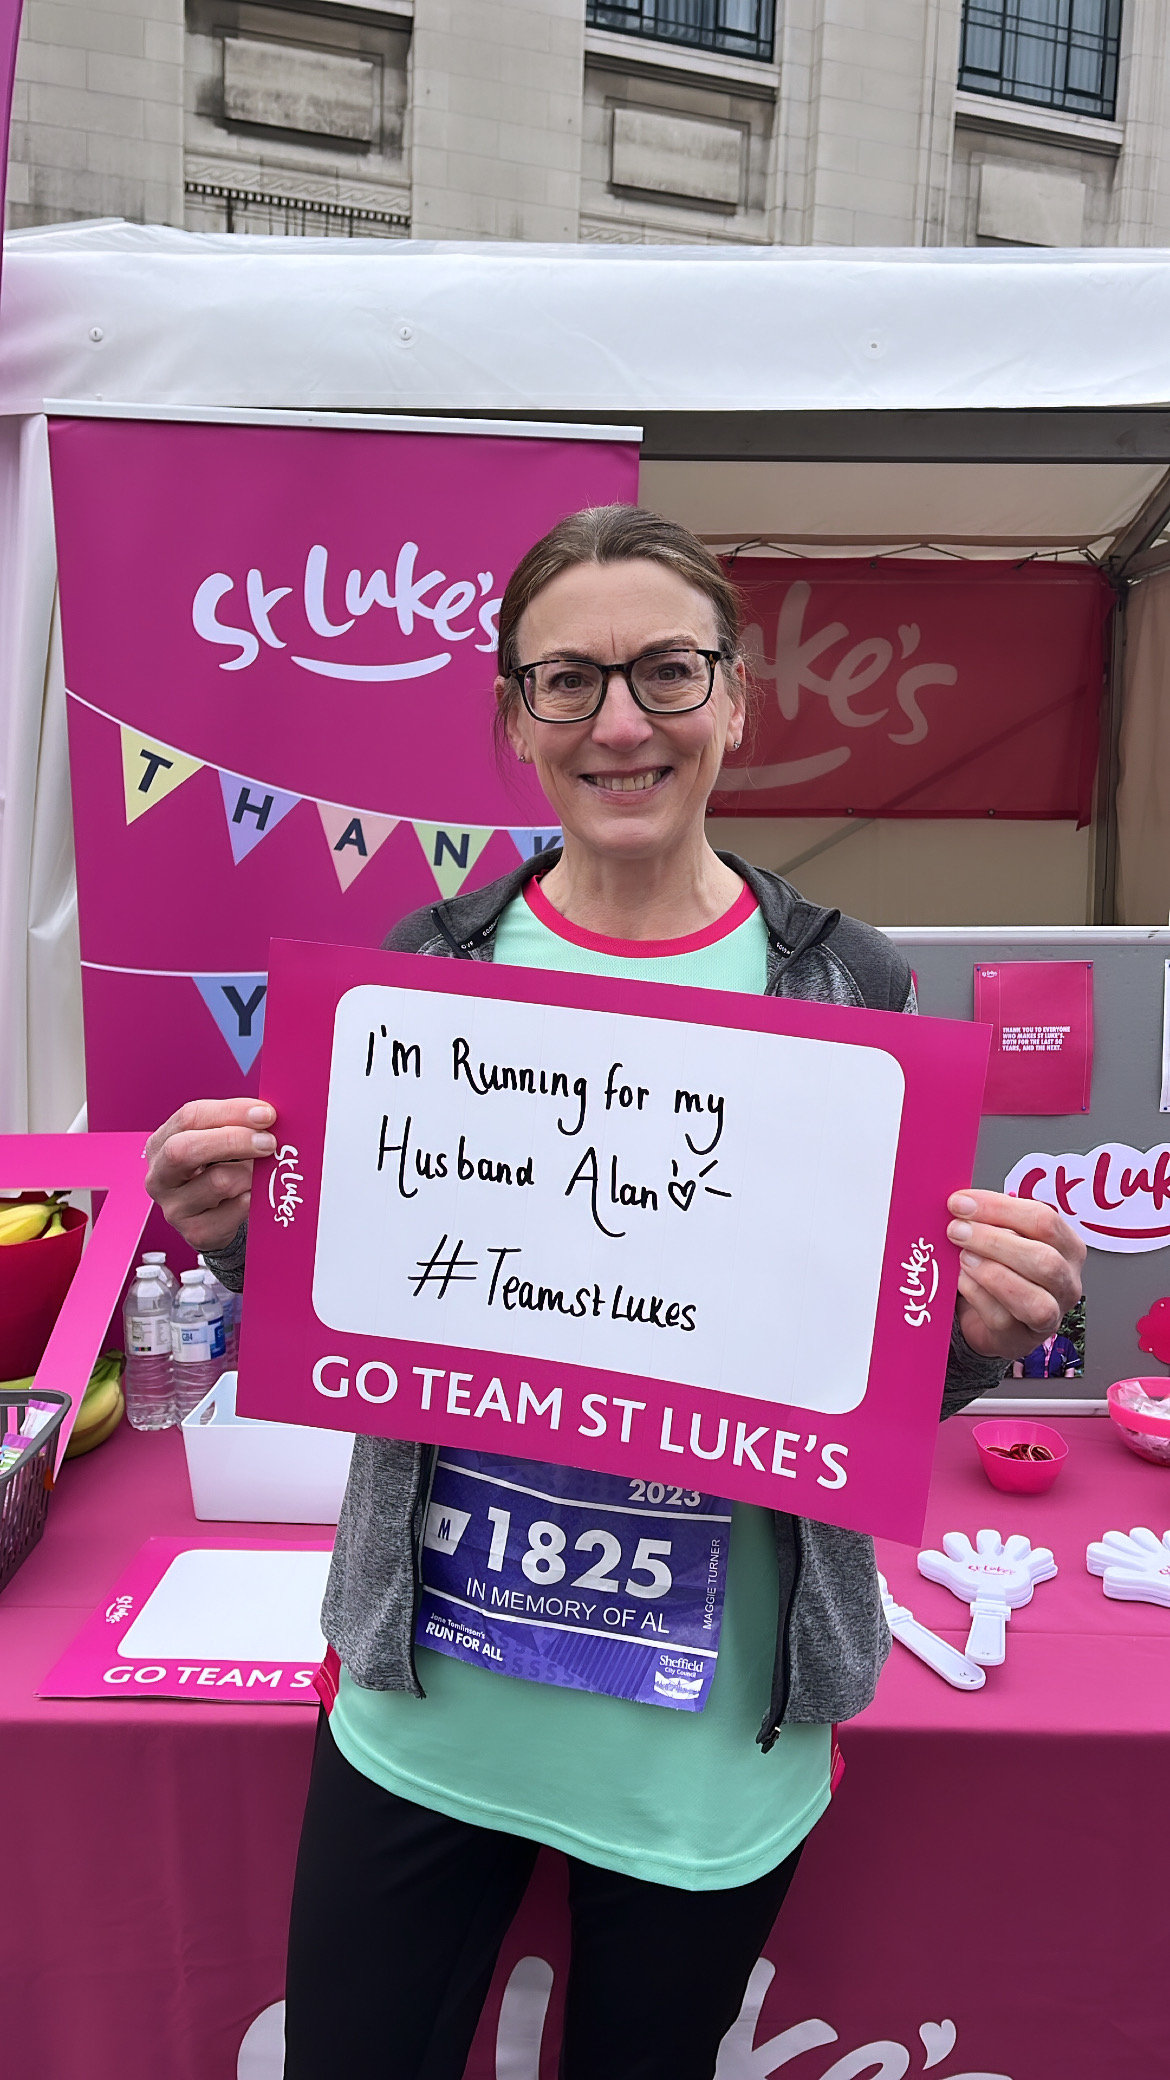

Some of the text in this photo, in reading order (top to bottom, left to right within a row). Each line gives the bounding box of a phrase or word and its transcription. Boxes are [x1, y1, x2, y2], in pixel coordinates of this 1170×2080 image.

[192, 567, 293, 670] St
[365, 1025, 725, 1155] I'm Running for my
[274, 1172, 304, 1228] Luke's
[377, 1114, 659, 1238] Husband Alan
[899, 1237, 934, 1327] St Luke's
[311, 1355, 850, 1490] GO TEAM ST LUKE'S
[438, 1518, 451, 1541] M
[628, 1479, 701, 1507] 2023
[487, 1506, 673, 1599] 1825
[703, 1539, 720, 1630] MAGGIE TURNER
[426, 1621, 503, 1661] RUN FOR ALL
[466, 1577, 670, 1634] IN MEMORY OF AL
[103, 1666, 167, 1684] GO
[177, 1666, 283, 1688] TEAM
[659, 1654, 704, 1673] Sheffield
